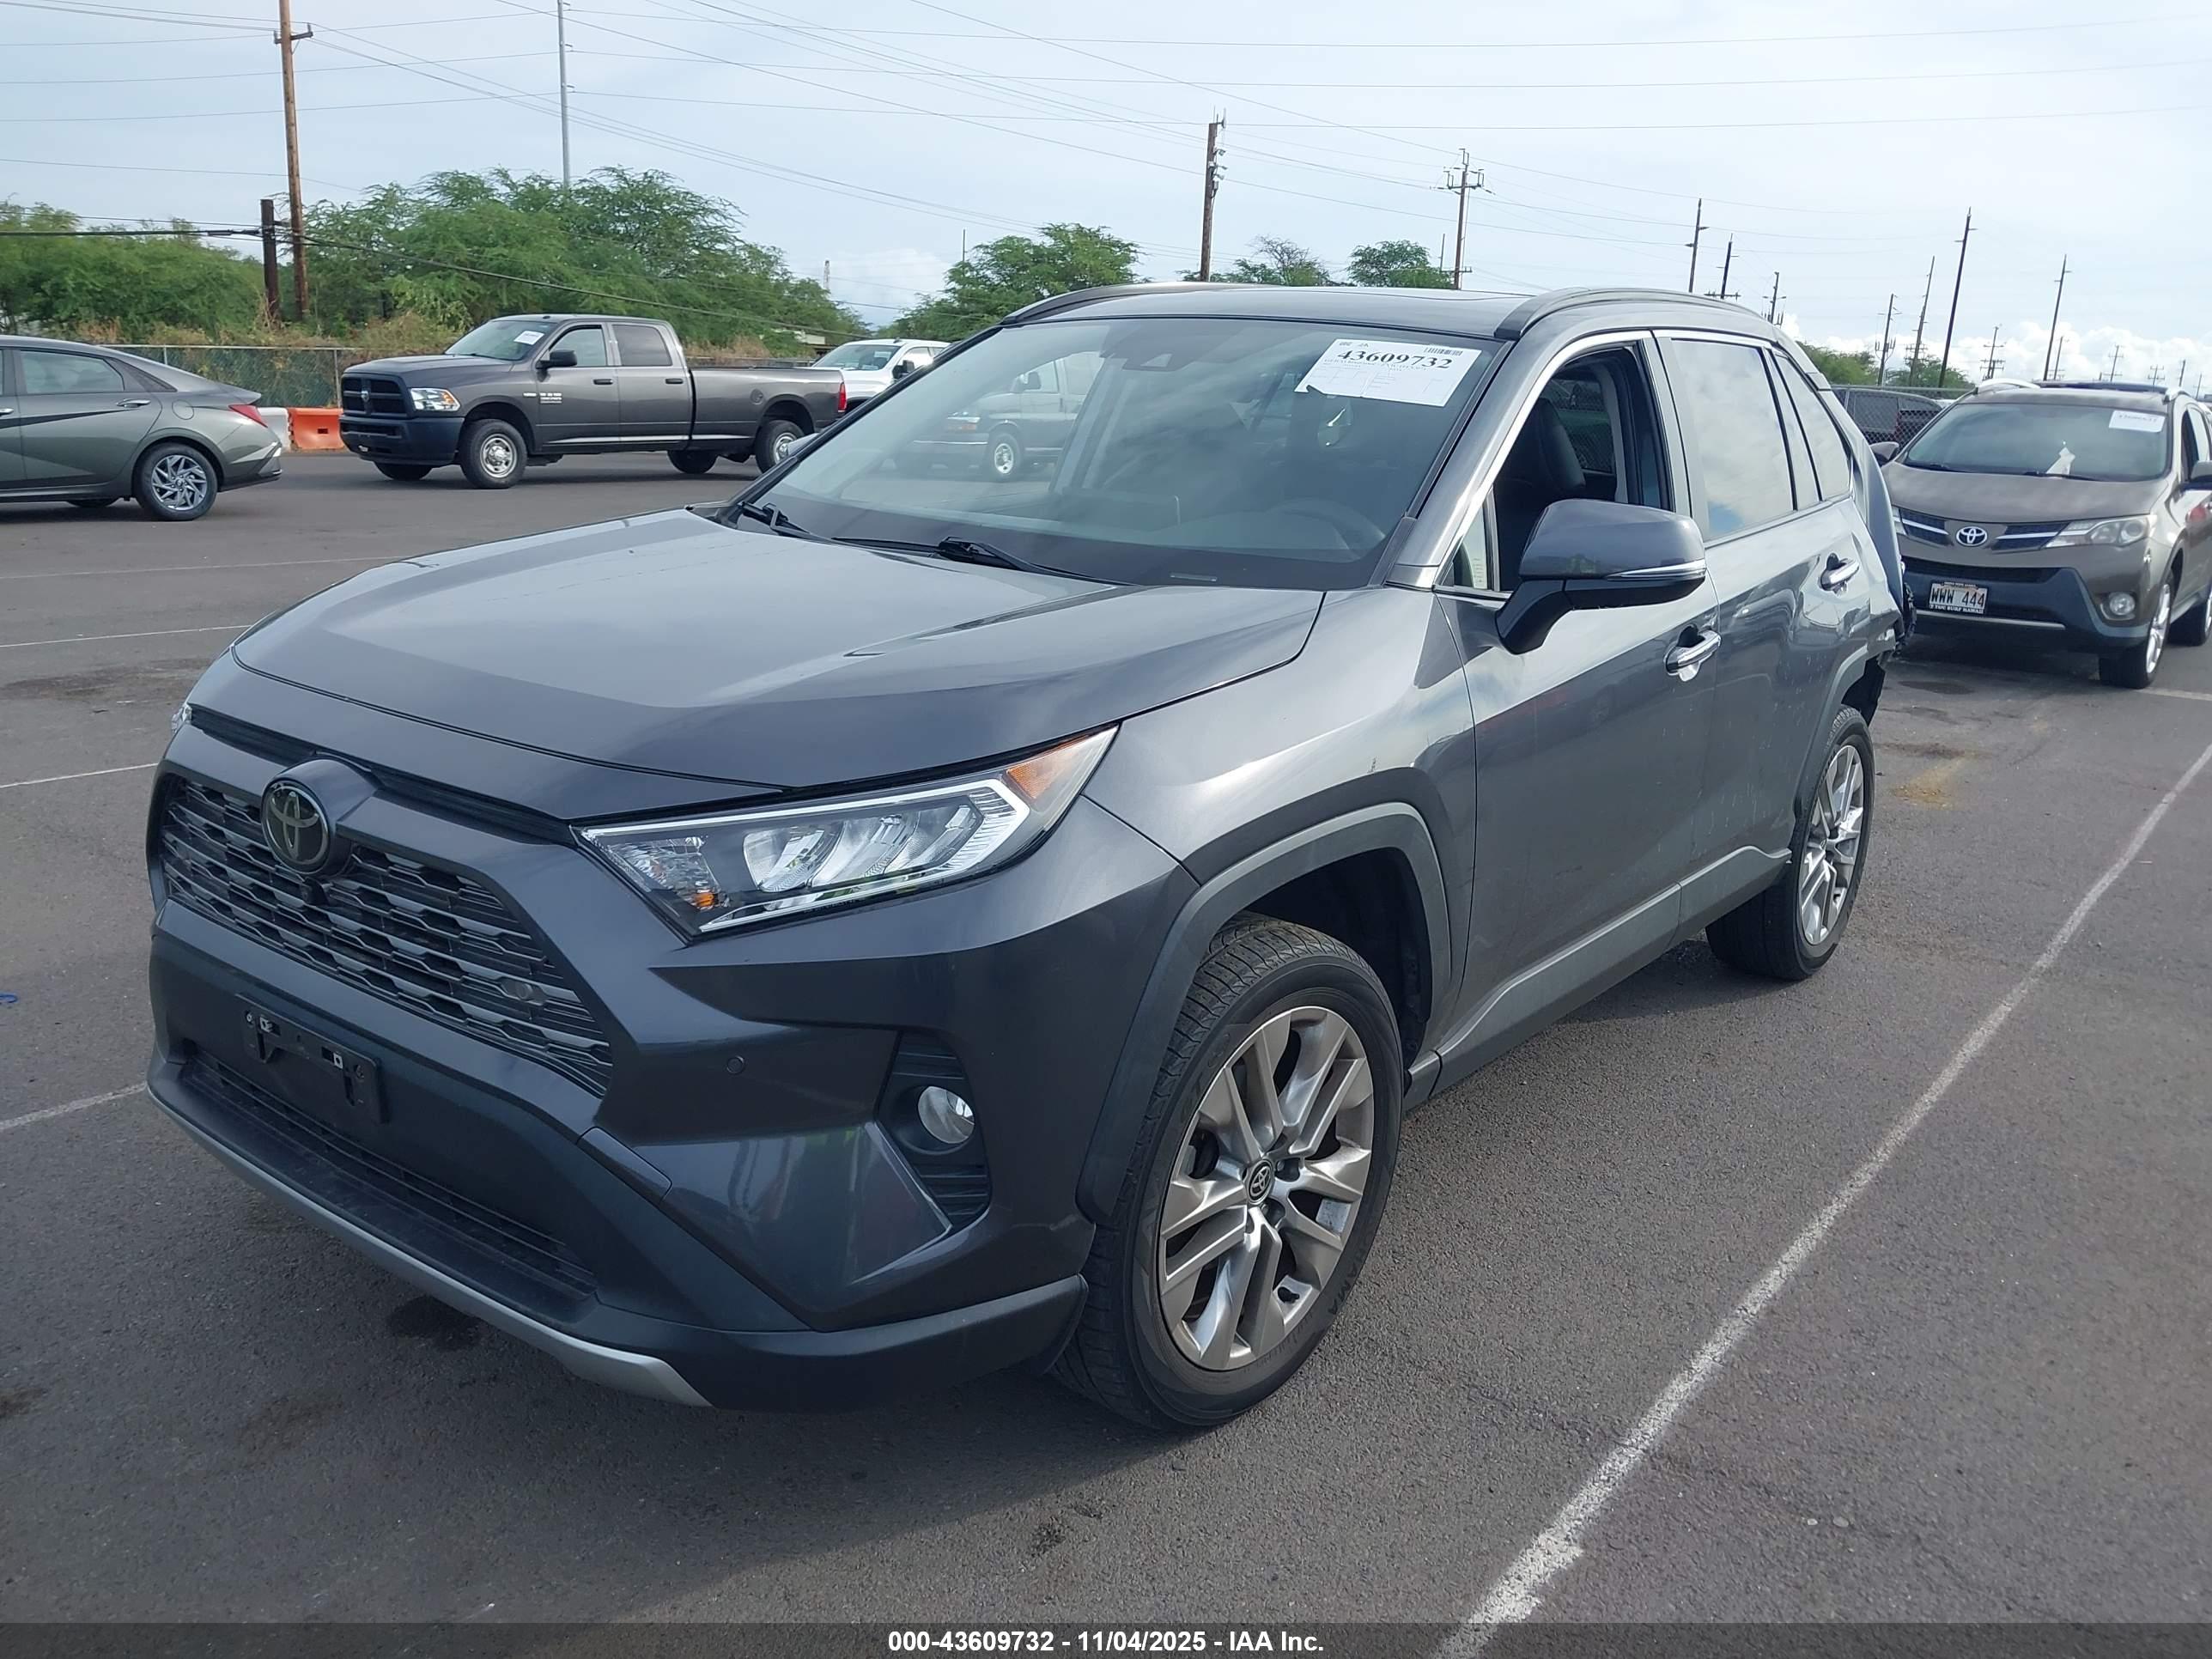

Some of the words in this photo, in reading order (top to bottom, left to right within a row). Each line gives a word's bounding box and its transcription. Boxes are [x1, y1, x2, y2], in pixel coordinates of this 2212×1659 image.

[1338, 349, 1453, 369] 43609732
[1931, 587, 1954, 604] WWW
[1961, 591, 1985, 607] 444
